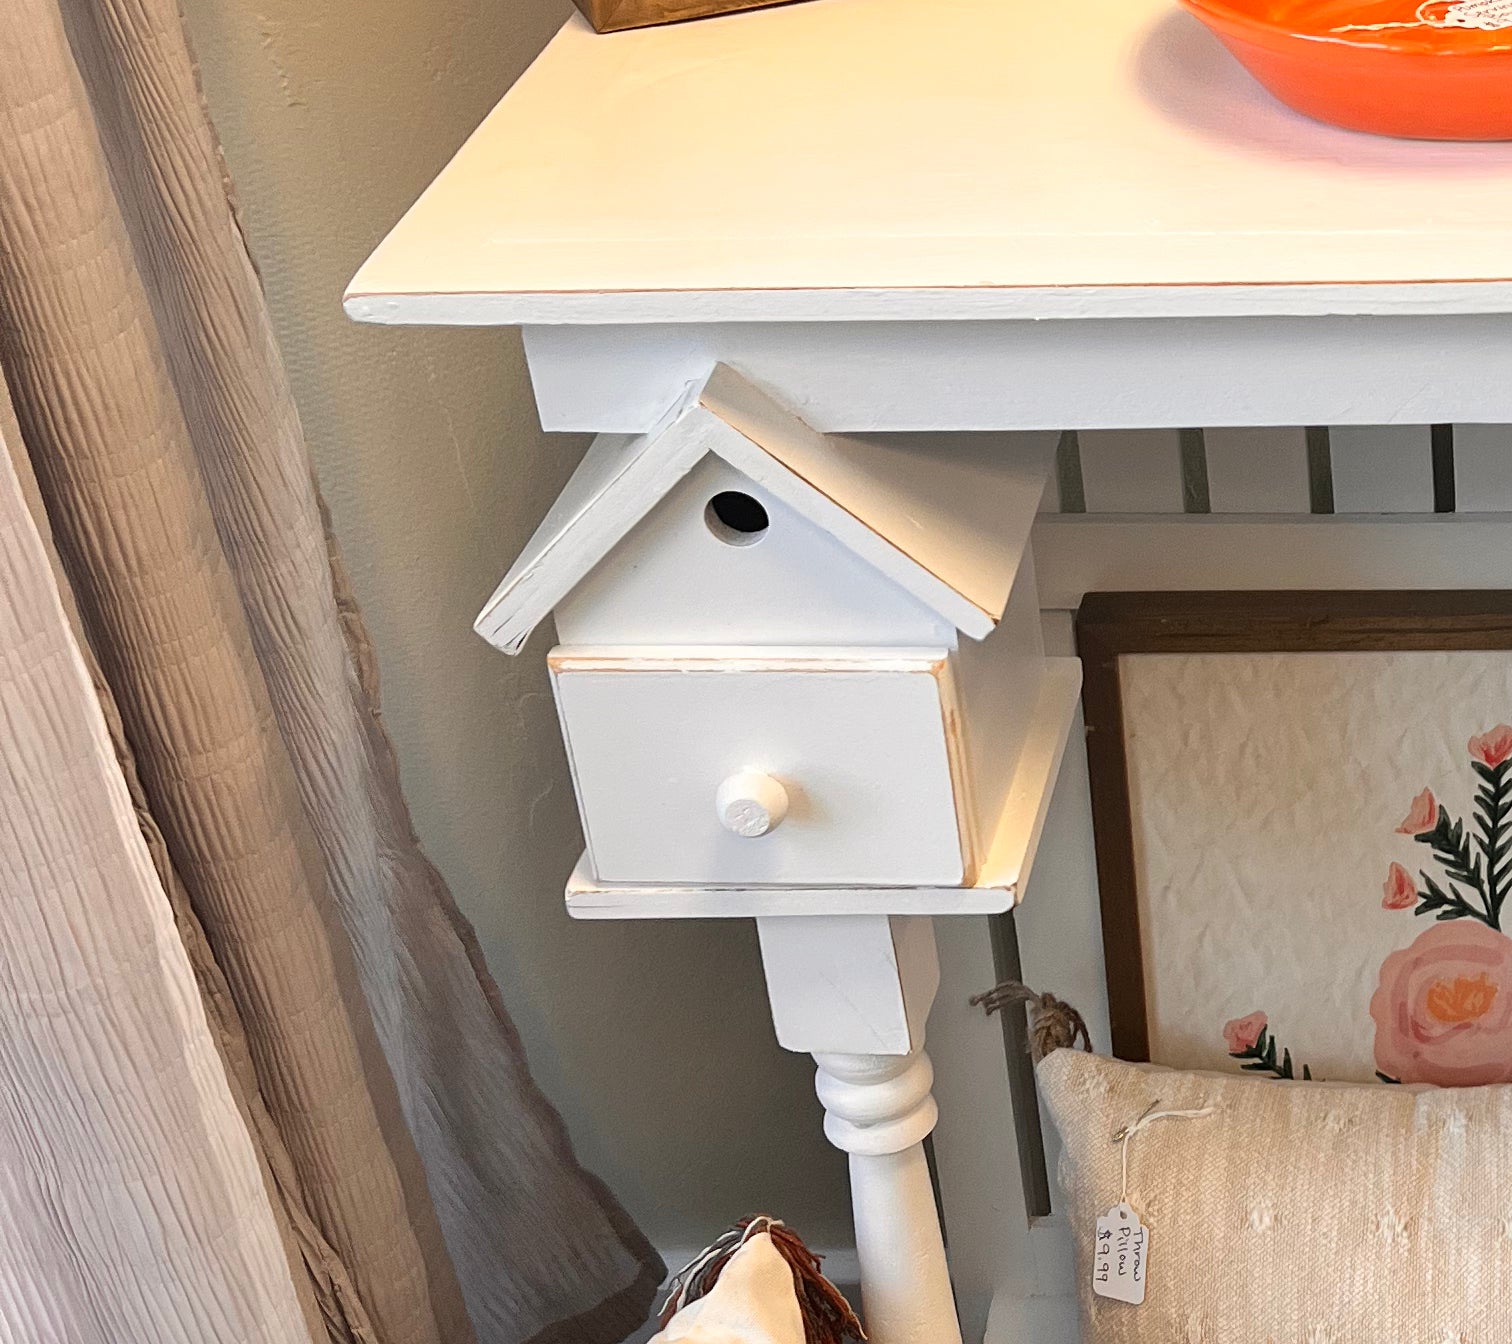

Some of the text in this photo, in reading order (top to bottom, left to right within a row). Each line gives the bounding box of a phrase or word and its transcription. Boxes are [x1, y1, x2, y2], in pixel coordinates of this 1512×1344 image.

[1095, 1227, 1113, 1282] $9.99
[1117, 1227, 1131, 1276] Pillow
[1133, 1226, 1144, 1282] Throw
